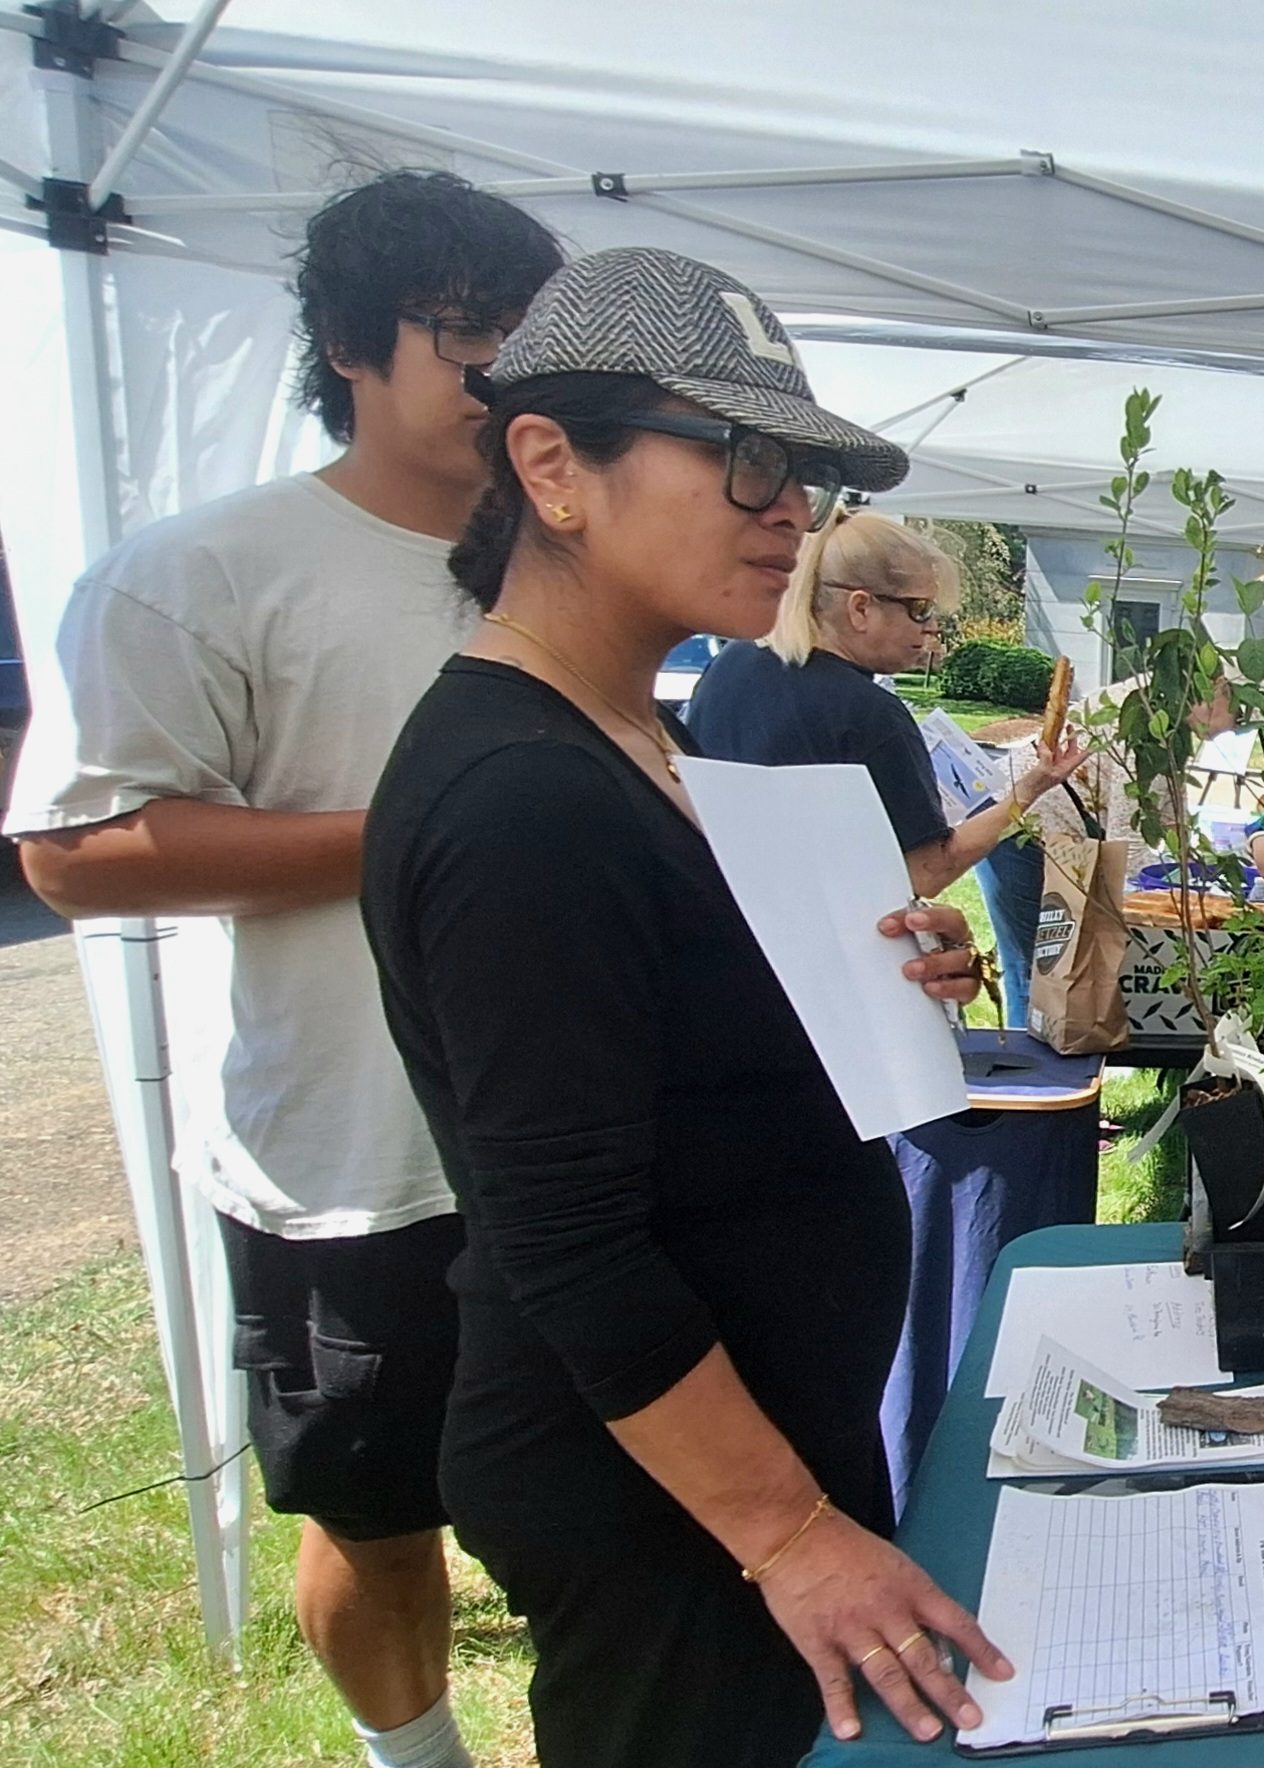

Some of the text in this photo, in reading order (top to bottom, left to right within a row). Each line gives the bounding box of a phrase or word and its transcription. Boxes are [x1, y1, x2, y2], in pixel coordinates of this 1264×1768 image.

[722, 292, 794, 366] L
[1040, 910, 1065, 922] HILLY
[1134, 965, 1165, 974] MAD
